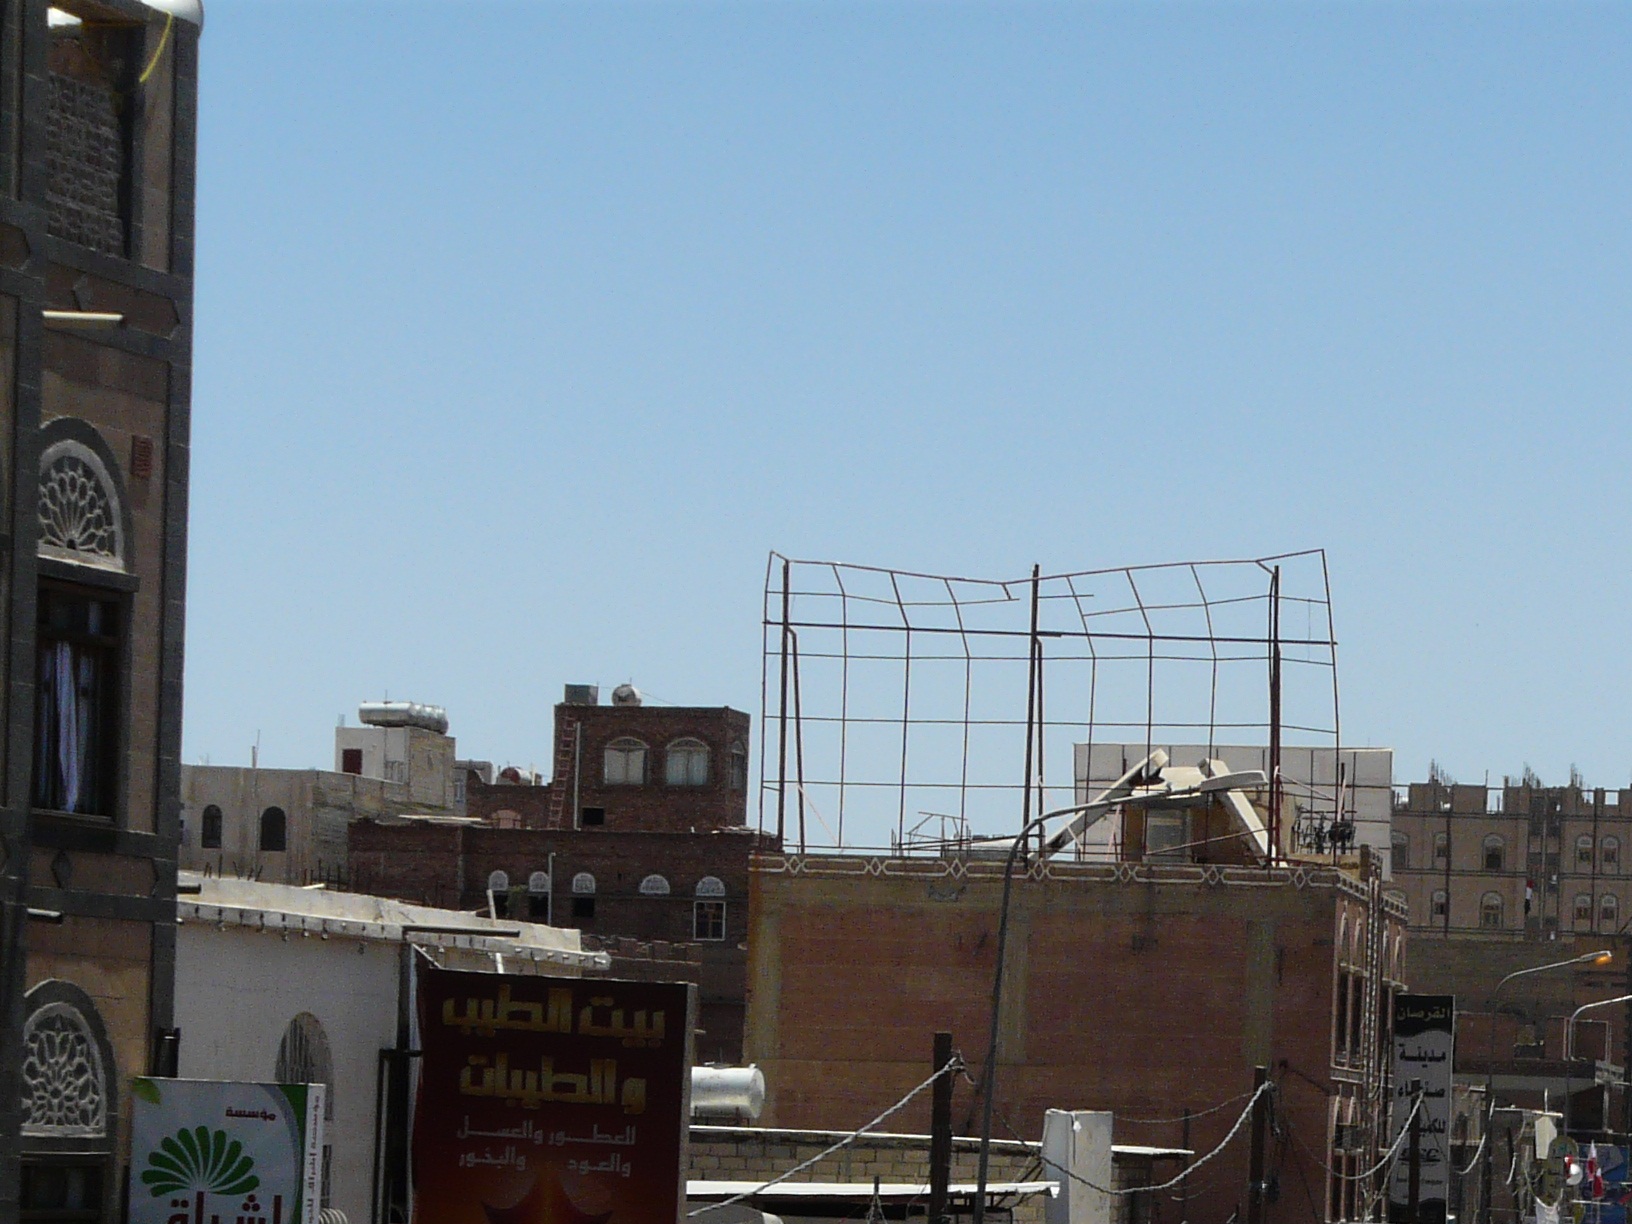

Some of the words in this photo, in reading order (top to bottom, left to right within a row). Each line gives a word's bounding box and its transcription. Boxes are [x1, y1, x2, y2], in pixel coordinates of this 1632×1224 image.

[441, 983, 574, 1038] الطيب
[578, 995, 666, 1048] بيت
[1399, 1043, 1446, 1069] مدينة
[226, 1106, 277, 1121] مؤسسة
[456, 1115, 544, 1146] والعسل
[547, 1122, 637, 1147] للعطور
[458, 1146, 528, 1173] والبخور
[567, 1152, 632, 1178] والعود
